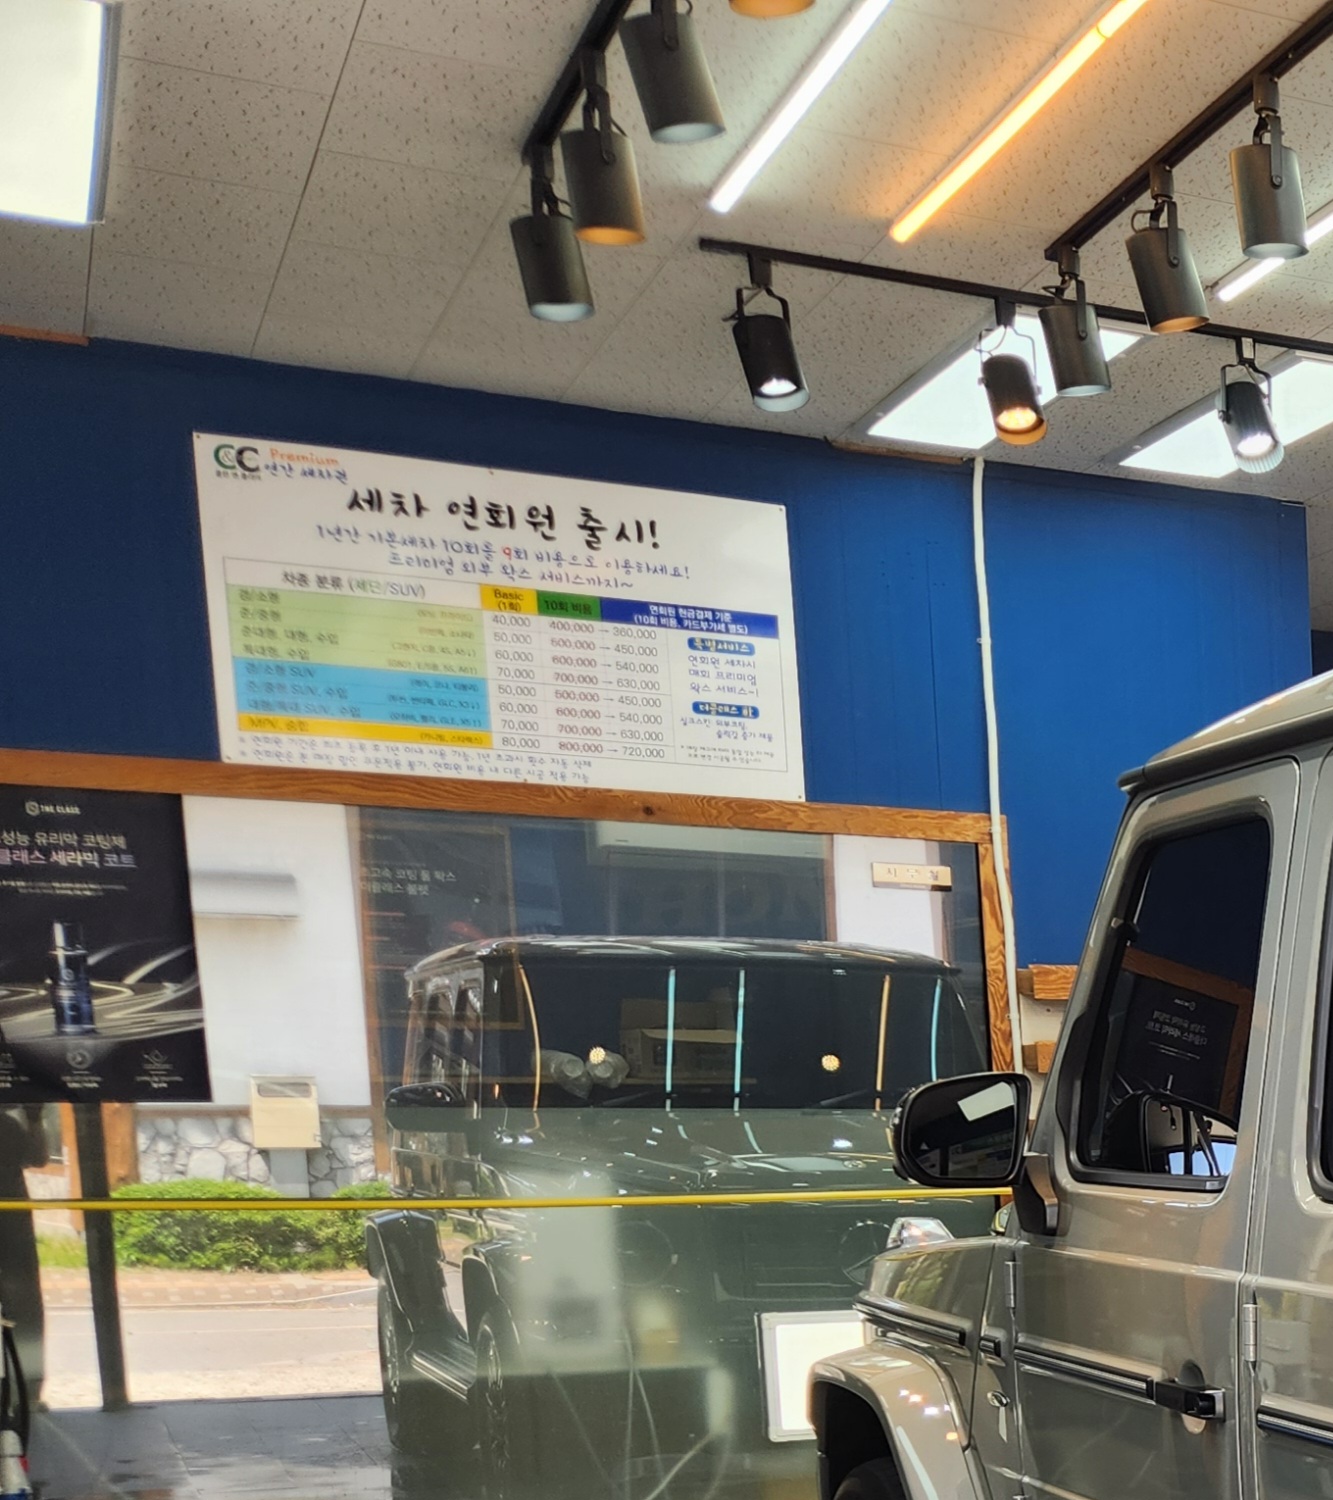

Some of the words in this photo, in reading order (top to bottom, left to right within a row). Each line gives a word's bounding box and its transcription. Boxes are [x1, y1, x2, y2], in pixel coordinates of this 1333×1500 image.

[269, 447, 340, 466] Premium
[264, 461, 294, 477] 연간
[347, 487, 430, 518] 세차
[447, 494, 557, 541] 연회원
[577, 506, 660, 551] 출시!
[316, 524, 361, 544] 1년간
[368, 530, 438, 550] 기본세차
[442, 538, 497, 563] 10회를
[502, 546, 528, 561] 9회
[535, 550, 599, 570] 비용으로
[605, 558, 690, 580] 이용하세요!
[388, 551, 455, 576] 프리미엄
[461, 560, 494, 576] 외부
[500, 564, 532, 582] 왁스
[539, 571, 634, 589] 서비스까지~
[494, 588, 524, 601] Basic
[544, 600, 569, 612] 10회
[572, 602, 592, 615] 비용
[492, 614, 531, 628] 40,000
[634, 614, 658, 627] (10회
[715, 610, 732, 623] 기준
[493, 632, 532, 645] 50,000
[549, 620, 594, 635] 400,000
[613, 626, 657, 640] 360,000
[550, 637, 596, 652] 500,000
[614, 643, 658, 657] 450,000
[495, 649, 534, 663] 60,000
[688, 655, 720, 669] 연회원
[724, 658, 756, 669] 세차시
[497, 667, 535, 680] 70,000
[552, 655, 597, 669] 600,000
[616, 661, 659, 675] 540,000
[554, 672, 598, 686] 700,000
[616, 678, 660, 692] 630,000
[688, 668, 711, 679] 매회
[715, 670, 757, 686] 프리미엄
[498, 684, 537, 698] 50,000
[690, 682, 712, 694] 왁스
[555, 689, 600, 703] 500,000
[618, 695, 662, 709] 450,000
[499, 702, 538, 715] 60,000
[556, 707, 601, 720] 600,000
[619, 712, 663, 726] 540,000
[501, 719, 539, 732] 70,000
[558, 724, 602, 737] 700,000
[620, 729, 664, 743] 630,000
[502, 736, 541, 750] 80,000
[559, 741, 603, 754] 800,000
[622, 746, 665, 760] 720,000
[34, 831, 80, 847] 유리막
[82, 833, 127, 850] 코팅제
[50, 849, 101, 868] 세라믹
[103, 852, 139, 869] 코트
